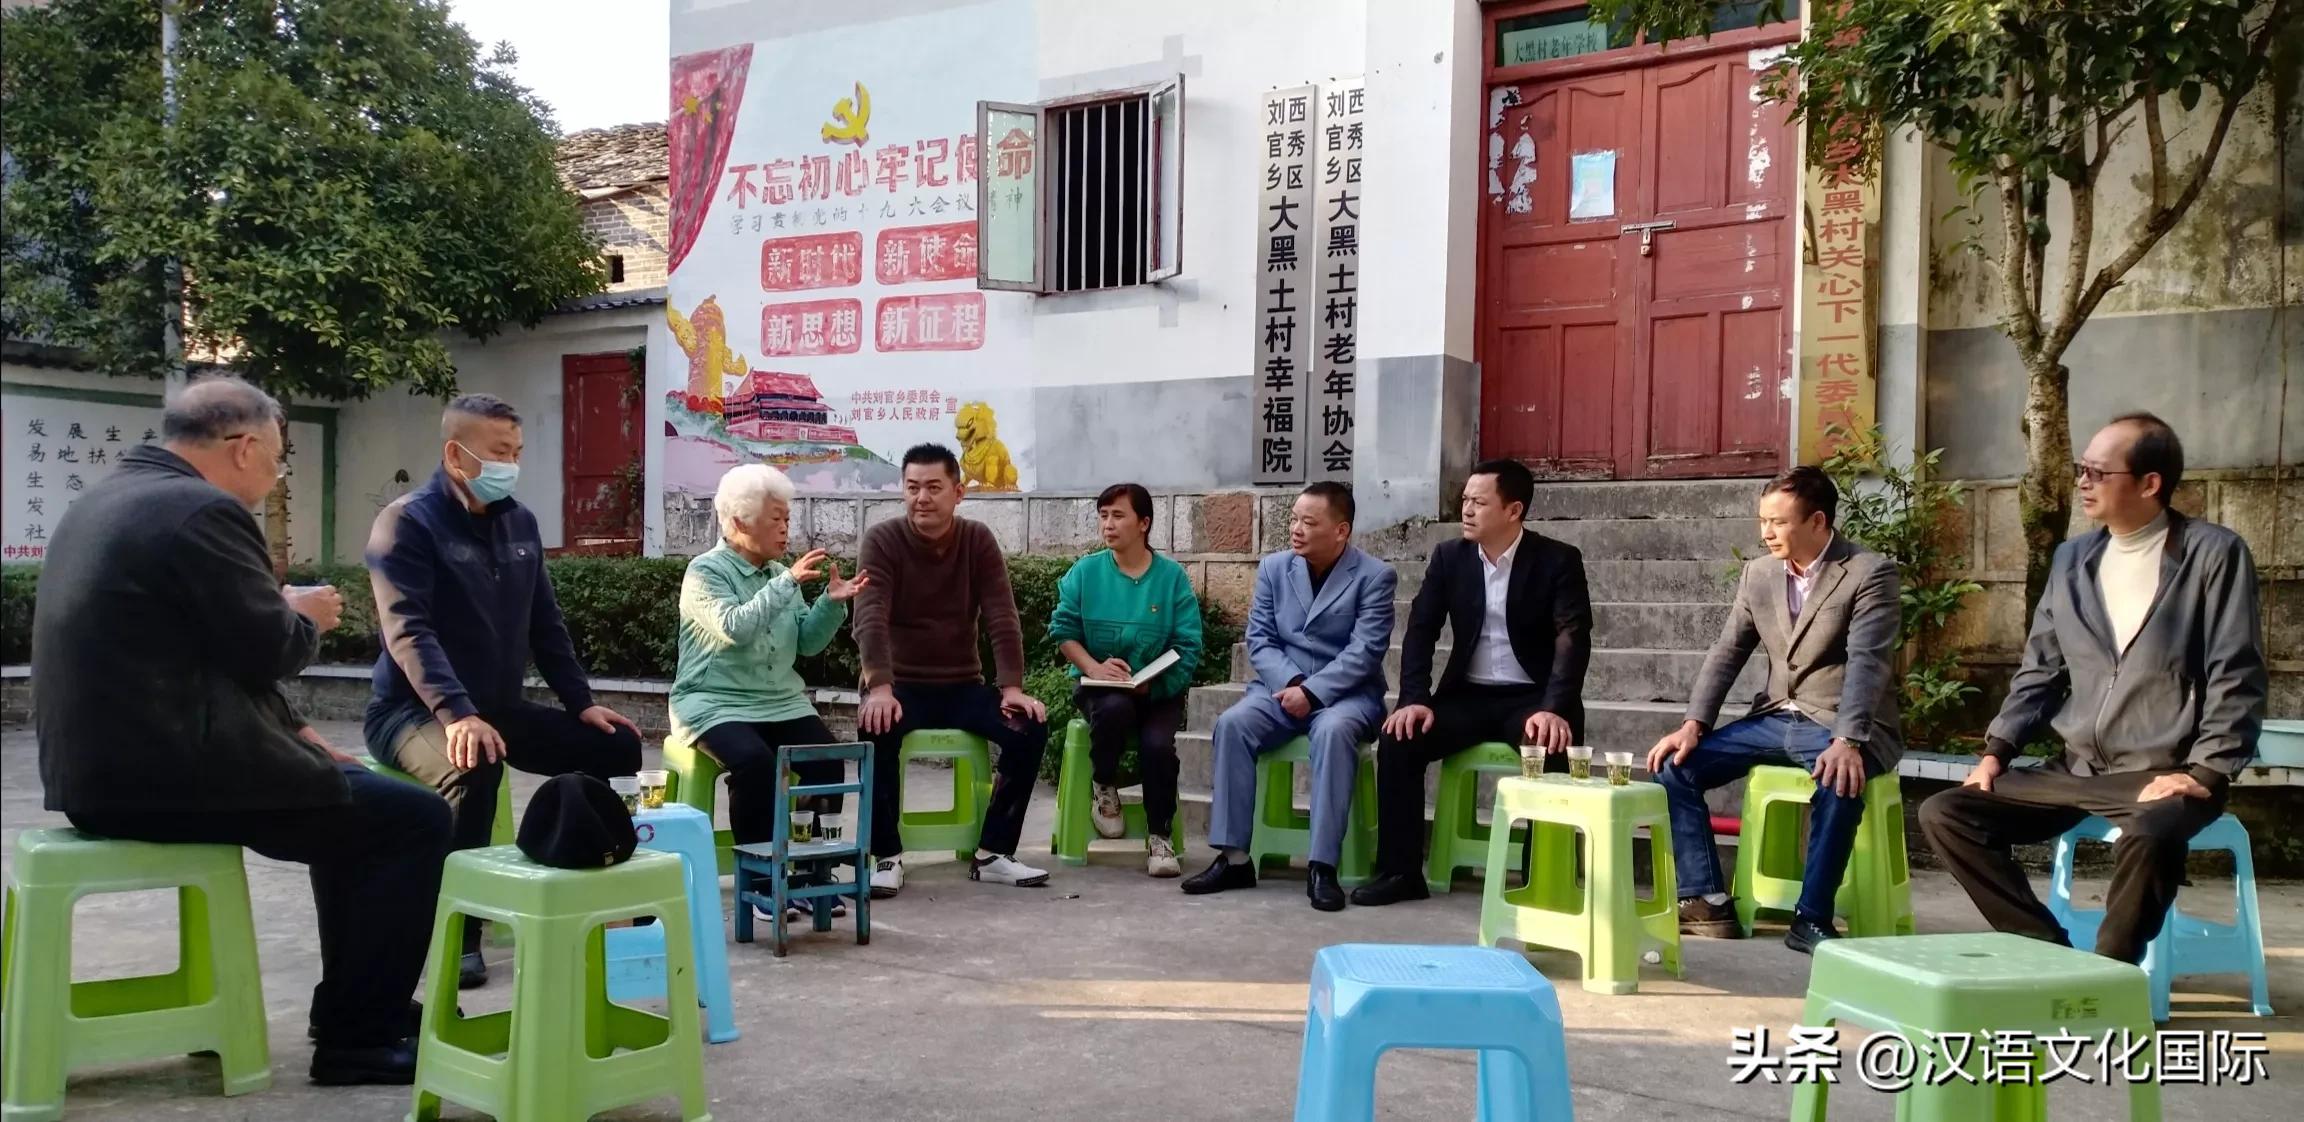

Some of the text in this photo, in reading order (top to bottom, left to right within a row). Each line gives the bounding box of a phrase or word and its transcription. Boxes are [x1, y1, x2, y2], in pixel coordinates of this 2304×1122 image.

[1266, 98, 1286, 190] 刘官乡
[1287, 96, 1307, 189] 西秀区
[1325, 90, 1345, 184] 刘官乡
[1347, 88, 1364, 183] 西秀区
[727, 128, 1034, 209] 不忘初心牢记使命
[767, 242, 857, 284] 新时代
[882, 232, 977, 277] 新使命
[767, 306, 857, 350] 新思想
[880, 299, 981, 346] 新征程
[1262, 195, 1299, 473] 大黑土村幸福院
[1322, 190, 1359, 472] 大黑土村老年协会
[851, 389, 941, 404] 中共刘官乡委员会
[851, 406, 940, 421] 刘官乡人民政府
[27, 443, 127, 465] 易地扶
